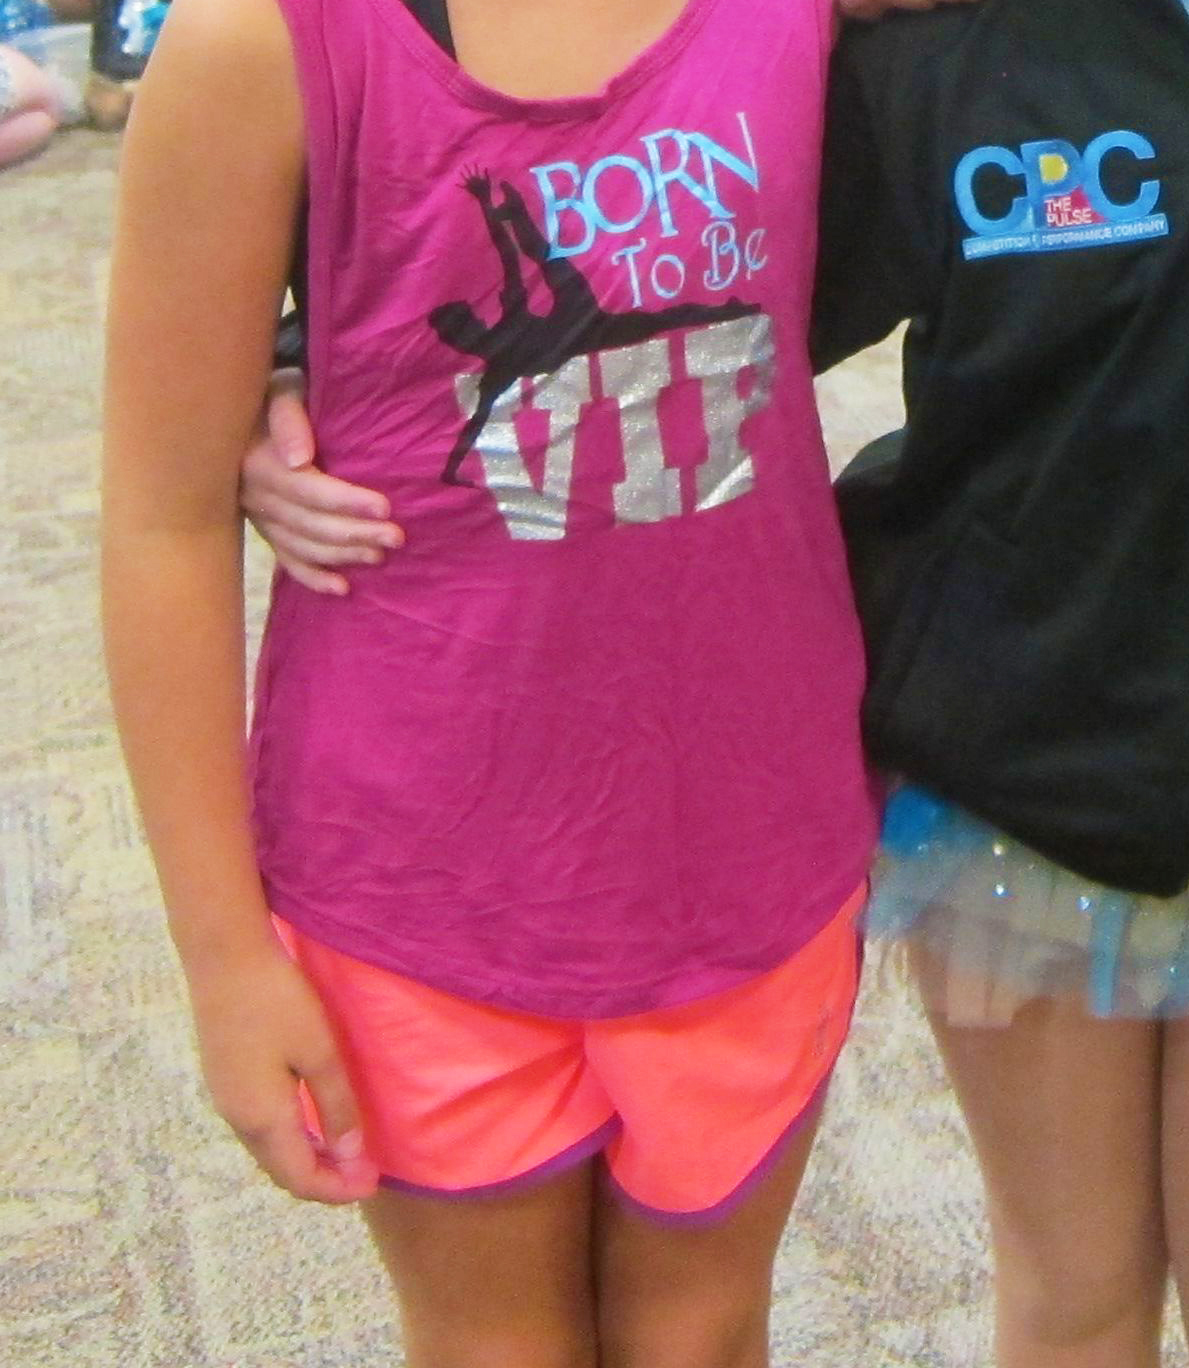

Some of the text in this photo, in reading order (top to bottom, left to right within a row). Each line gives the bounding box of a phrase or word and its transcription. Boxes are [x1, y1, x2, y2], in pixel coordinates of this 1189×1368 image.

[529, 112, 759, 260] BORN
[954, 130, 1161, 236] CPC
[1044, 196, 1071, 212] THE
[1045, 208, 1093, 227] PULSE
[454, 314, 776, 540] VIP
